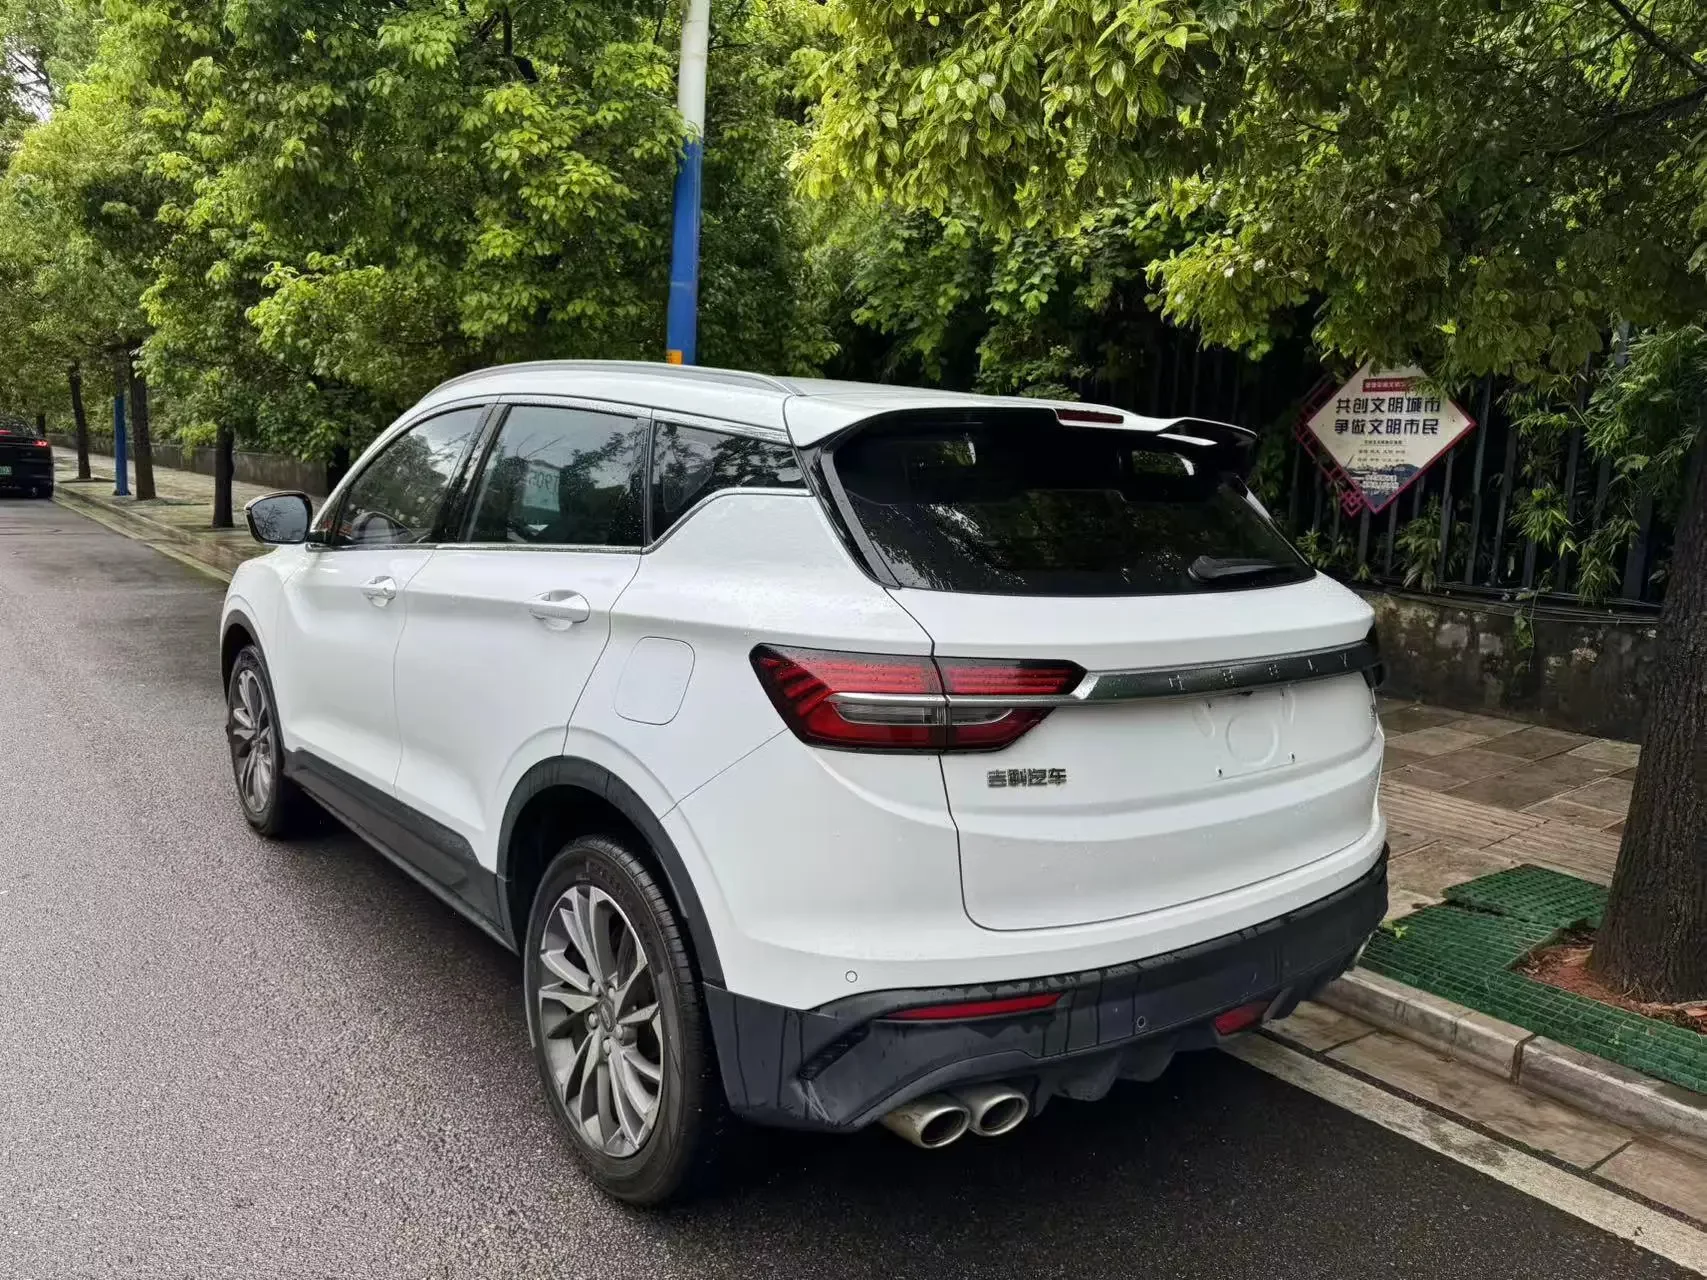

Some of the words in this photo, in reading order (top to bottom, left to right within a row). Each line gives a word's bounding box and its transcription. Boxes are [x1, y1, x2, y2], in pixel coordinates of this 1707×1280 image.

[1336, 397, 1441, 414] 共创文明城市
[1335, 418, 1439, 435] 争做文明市民
